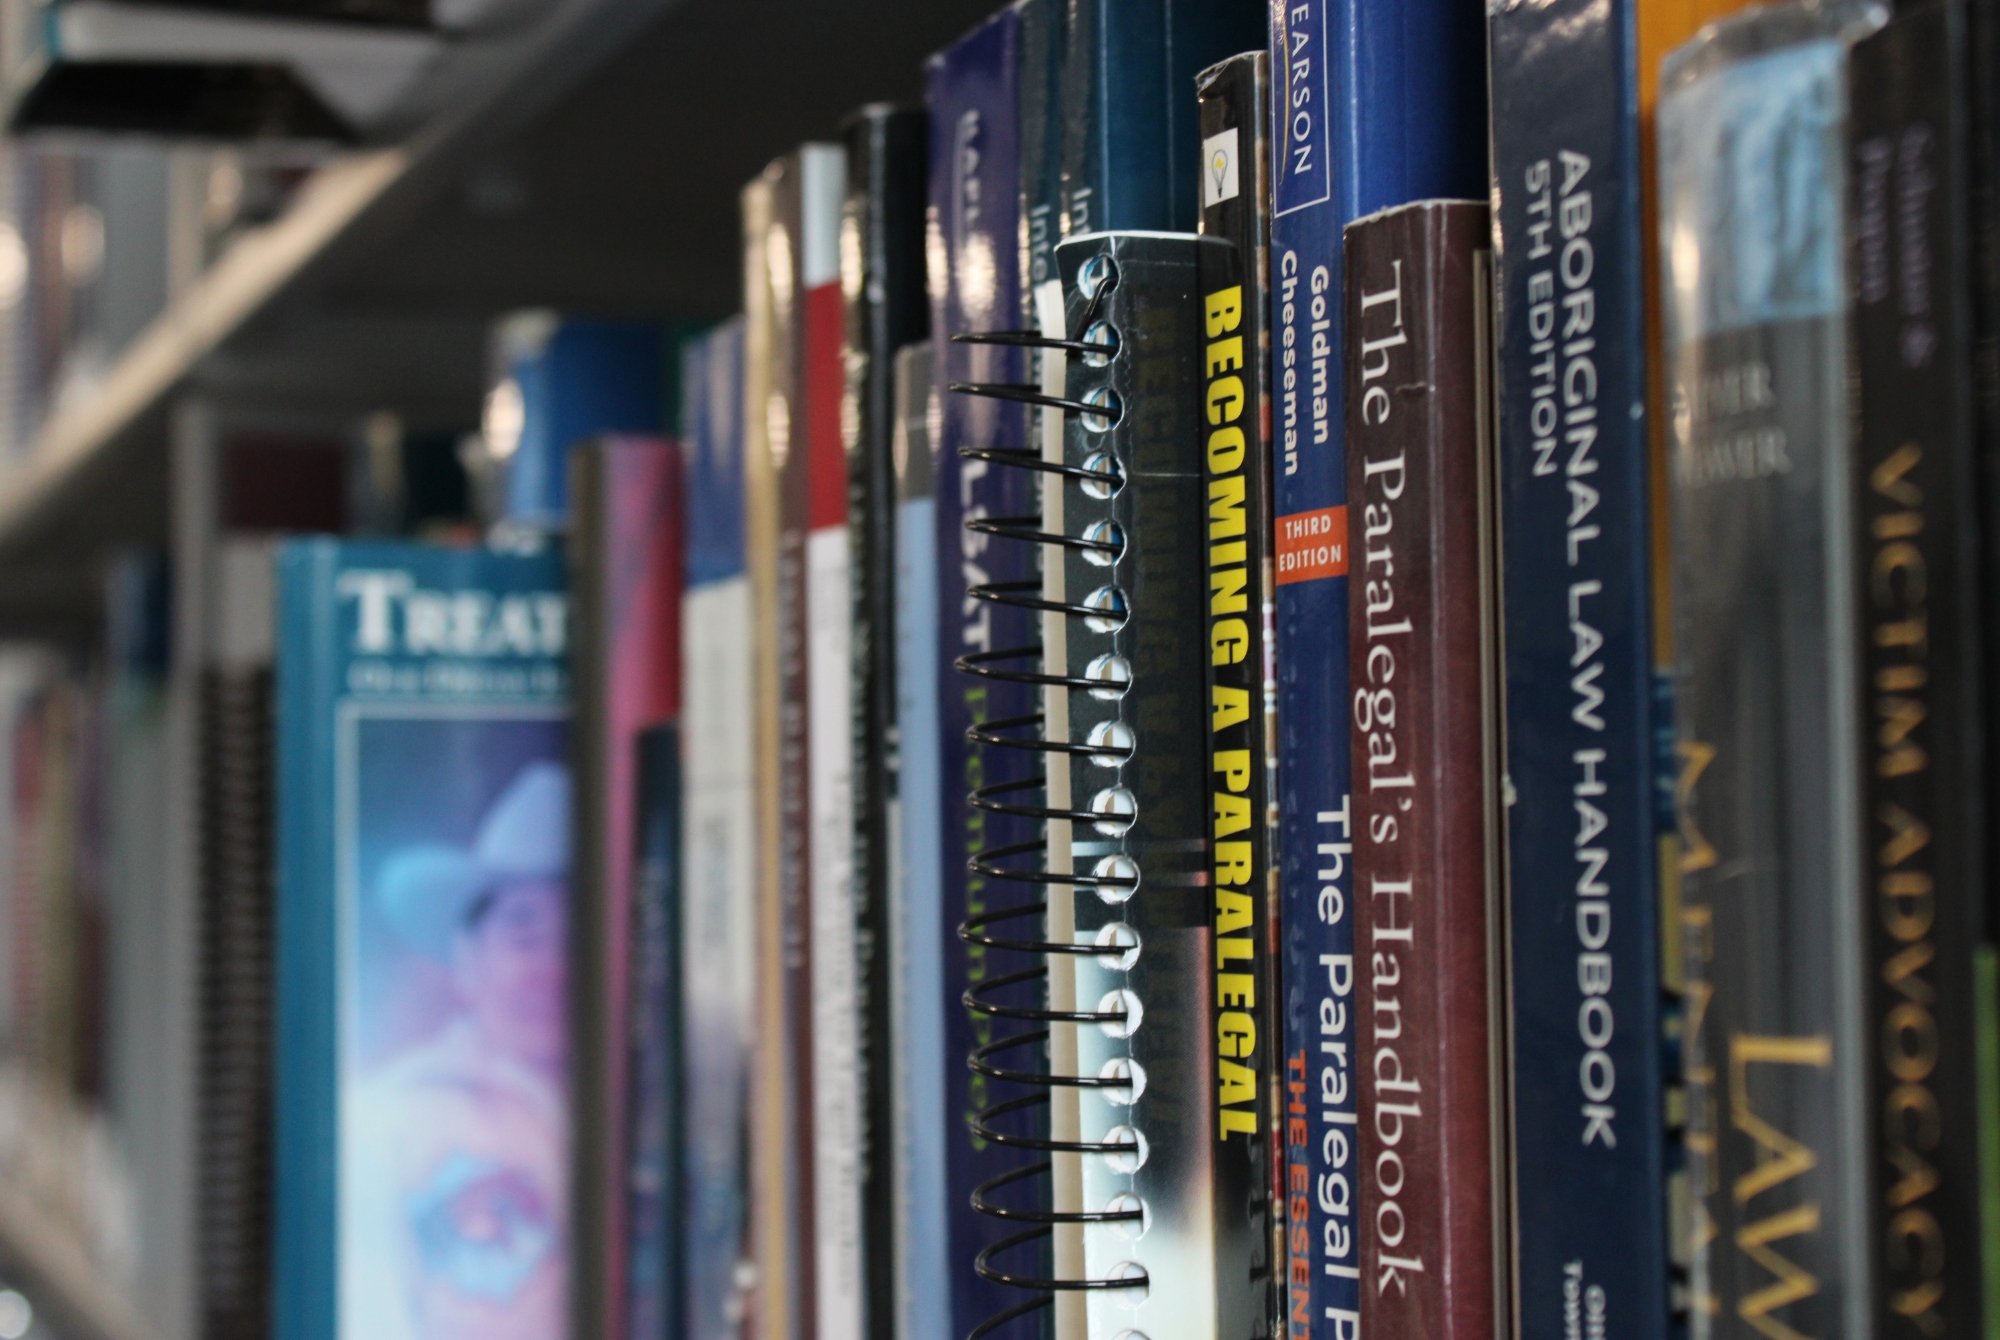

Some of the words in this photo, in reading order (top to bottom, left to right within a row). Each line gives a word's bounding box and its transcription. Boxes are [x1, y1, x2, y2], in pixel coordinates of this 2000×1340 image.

[1525, 159, 1553, 260] 5TH
[1280, 249, 1299, 476] Cheeseman
[1310, 264, 1331, 446] Goldman
[1361, 258, 1409, 426] The
[1527, 272, 1558, 477] EDITION
[1557, 149, 1601, 567] ABORIGINAL
[960, 457, 992, 652] LSAT
[1205, 285, 1250, 666] BECOMING
[1279, 544, 1342, 573] EDITION
[1285, 514, 1332, 540] THIRD
[1212, 684, 1251, 733] A
[1354, 452, 1417, 844] Paralegal's
[1568, 580, 1606, 731] LAW
[1869, 439, 1929, 780] VICTIM
[1212, 748, 1258, 1142] PARALEGAL
[1316, 793, 1353, 926] The
[1573, 749, 1617, 1149] HANDBOOK
[1287, 1049, 1308, 1147] THE
[1317, 953, 1361, 1280] Paralegal
[1370, 872, 1425, 1298] Handbook
[1877, 803, 1947, 1338] ADVOCACY
